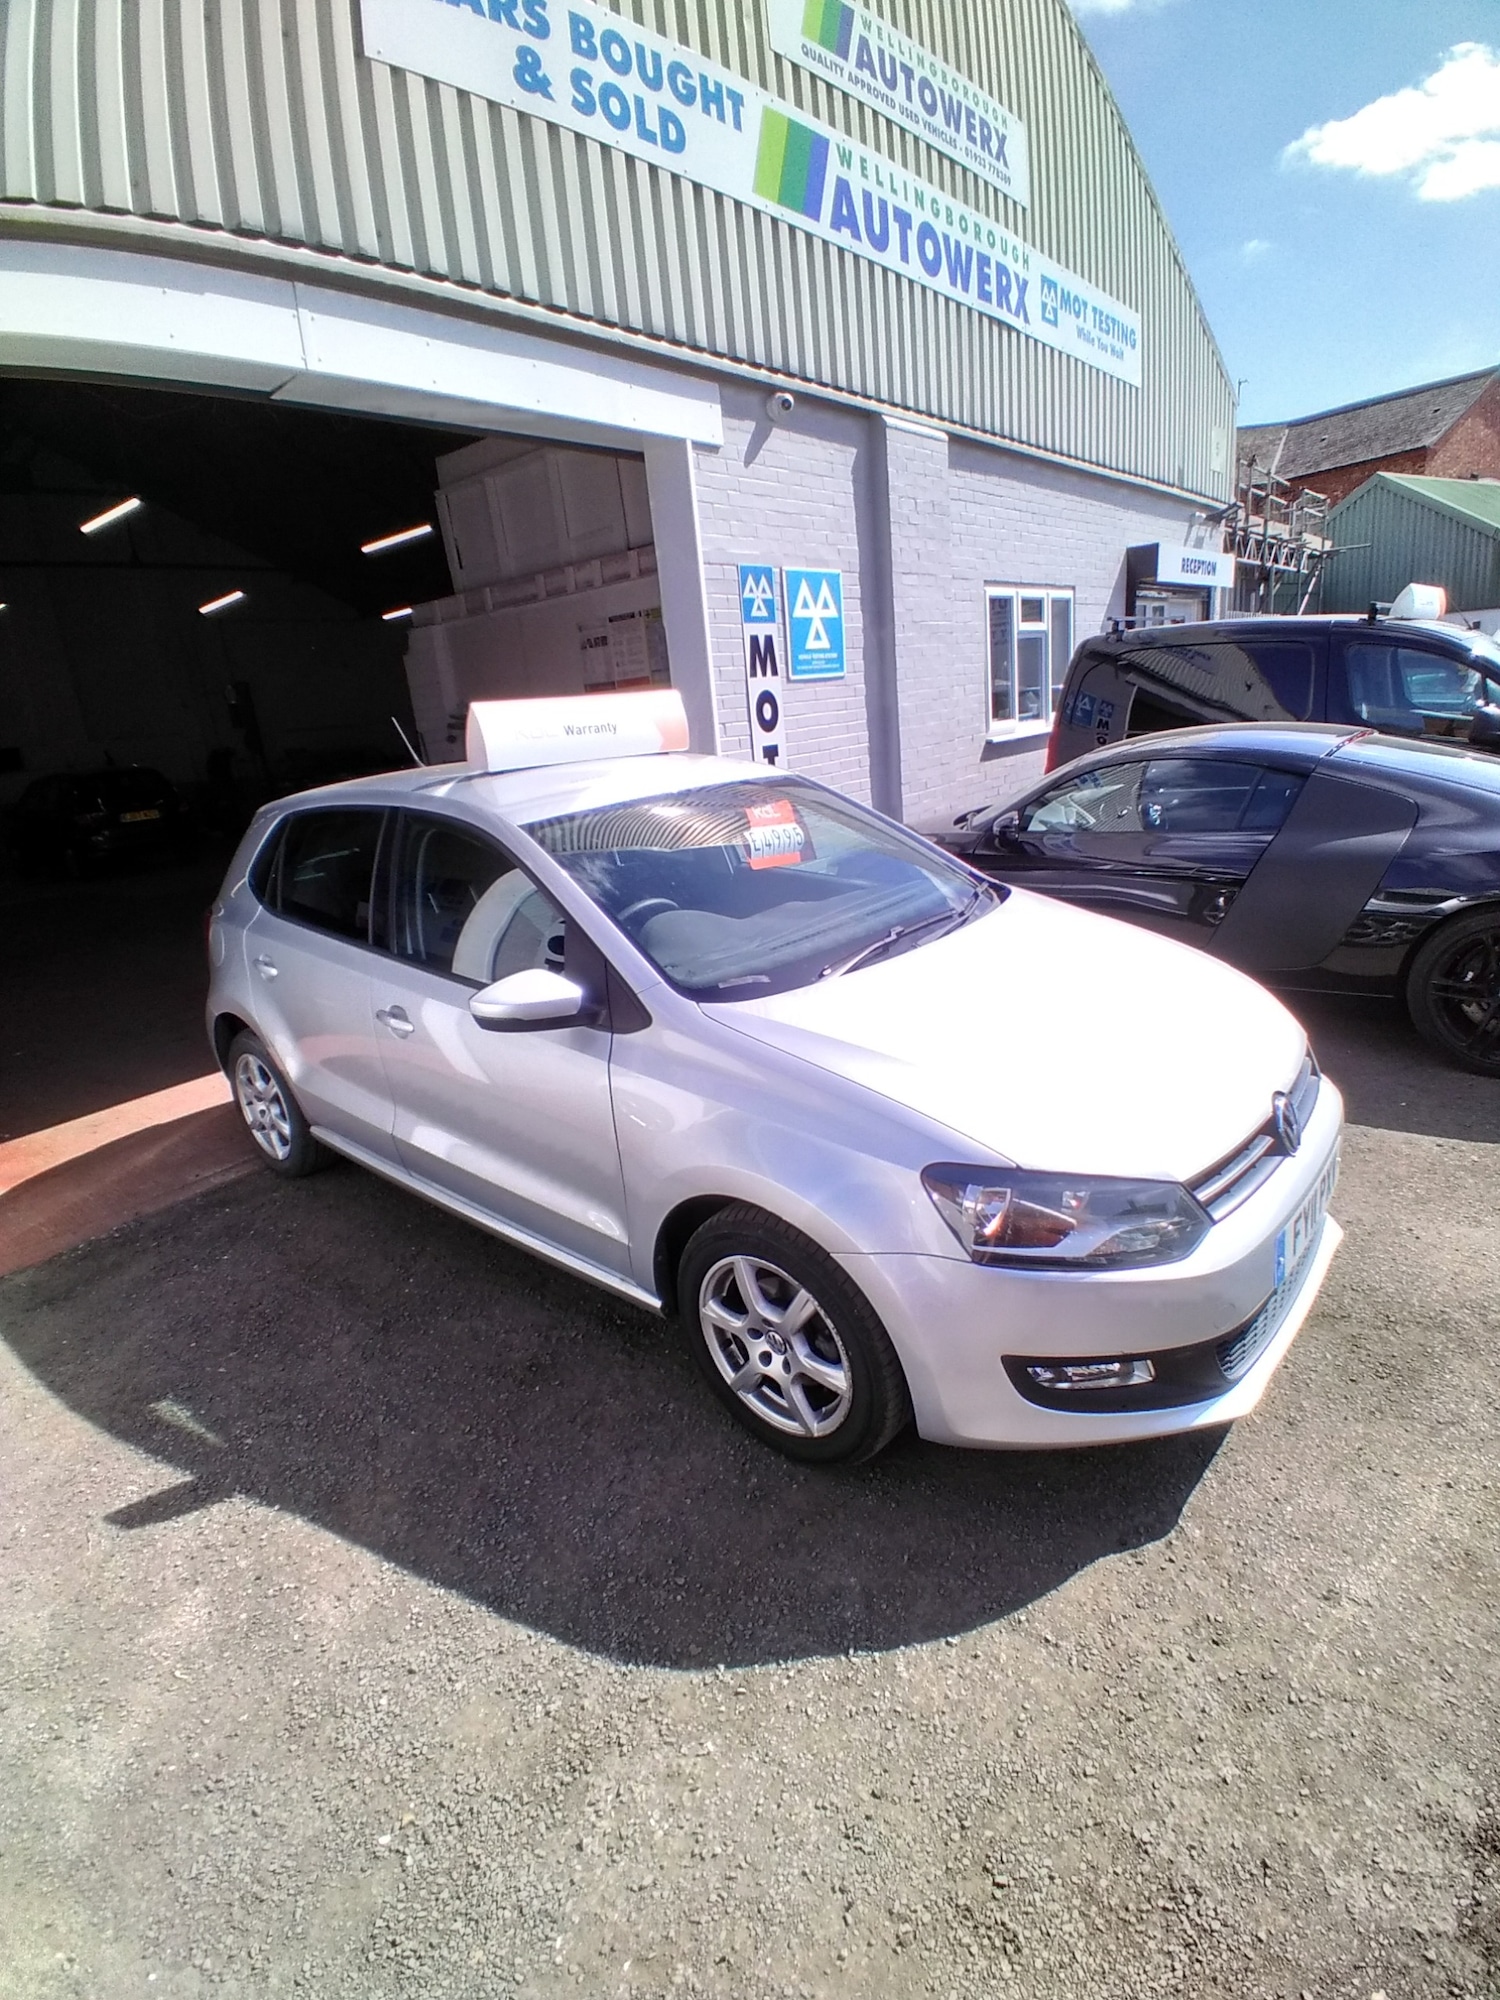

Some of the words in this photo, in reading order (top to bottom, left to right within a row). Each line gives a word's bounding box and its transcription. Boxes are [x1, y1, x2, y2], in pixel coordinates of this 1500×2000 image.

[512, 45, 556, 102] &
[569, 66, 686, 154] SOLD
[567, 9, 745, 133] BOUGHT
[801, 42, 845, 78] QUALITY
[848, 72, 896, 110] APPROVED
[899, 103, 920, 125] USED
[921, 117, 958, 150] VEHICLES
[855, 34, 1010, 169] AUTOWERX
[860, 14, 1009, 129] WELLINGBOROUGH
[829, 174, 1031, 326] AUTOWERX
[835, 142, 1031, 272] WELLINGBOROUGH
[1060, 287, 1088, 324] MOT
[1091, 305, 1137, 350] TESTING
[1075, 324, 1095, 346] While
[1180, 557, 1217, 577] RECEPTION
[563, 721, 618, 737] Warranty
[748, 826, 803, 852] £4995
